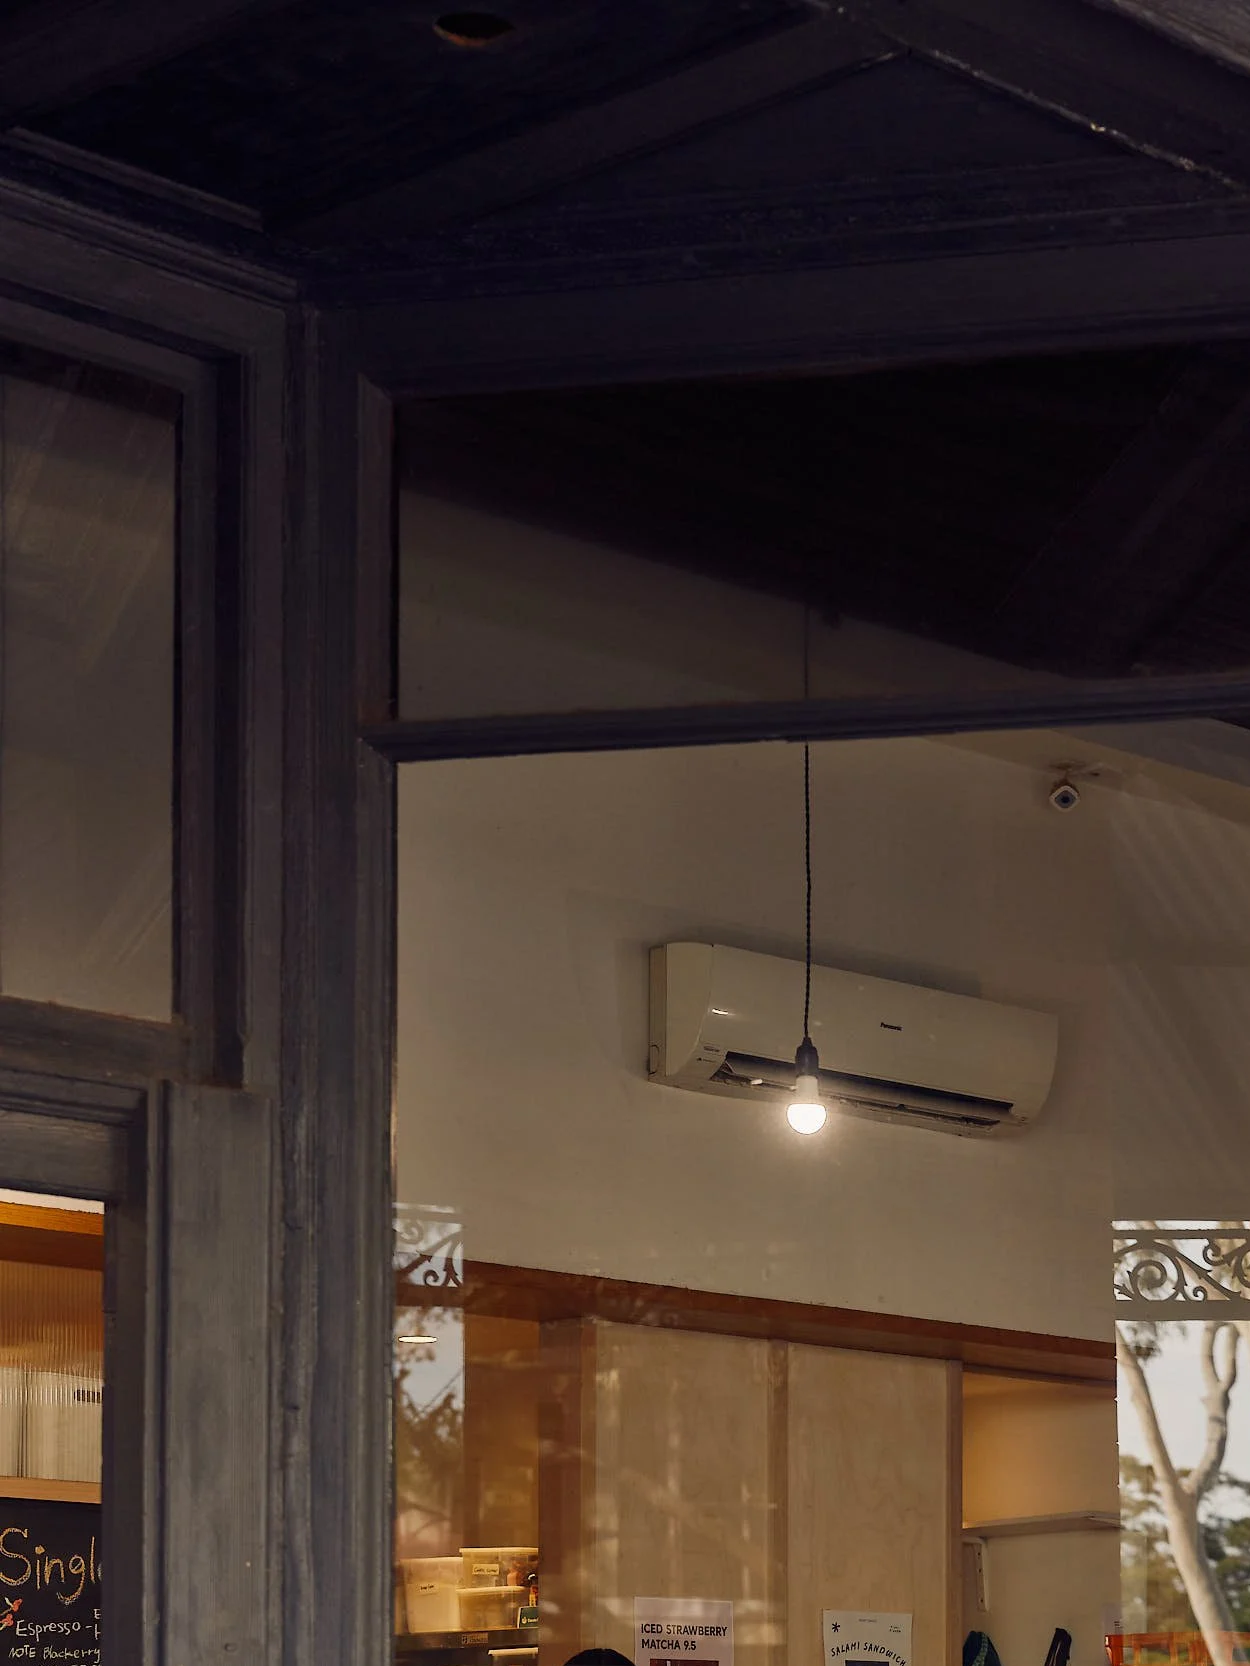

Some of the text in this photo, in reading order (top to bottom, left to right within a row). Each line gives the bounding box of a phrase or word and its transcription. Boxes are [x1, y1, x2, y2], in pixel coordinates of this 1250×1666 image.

[0, 1528, 102, 1606] Singl
[16, 1619, 81, 1642] Espresso
[641, 1623, 728, 1637] ICED STRAWBERRY
[8, 1645, 36, 1658] NOTE
[641, 1638, 697, 1650] MATCHA 9.5
[831, 1641, 860, 1657] SALAMI
